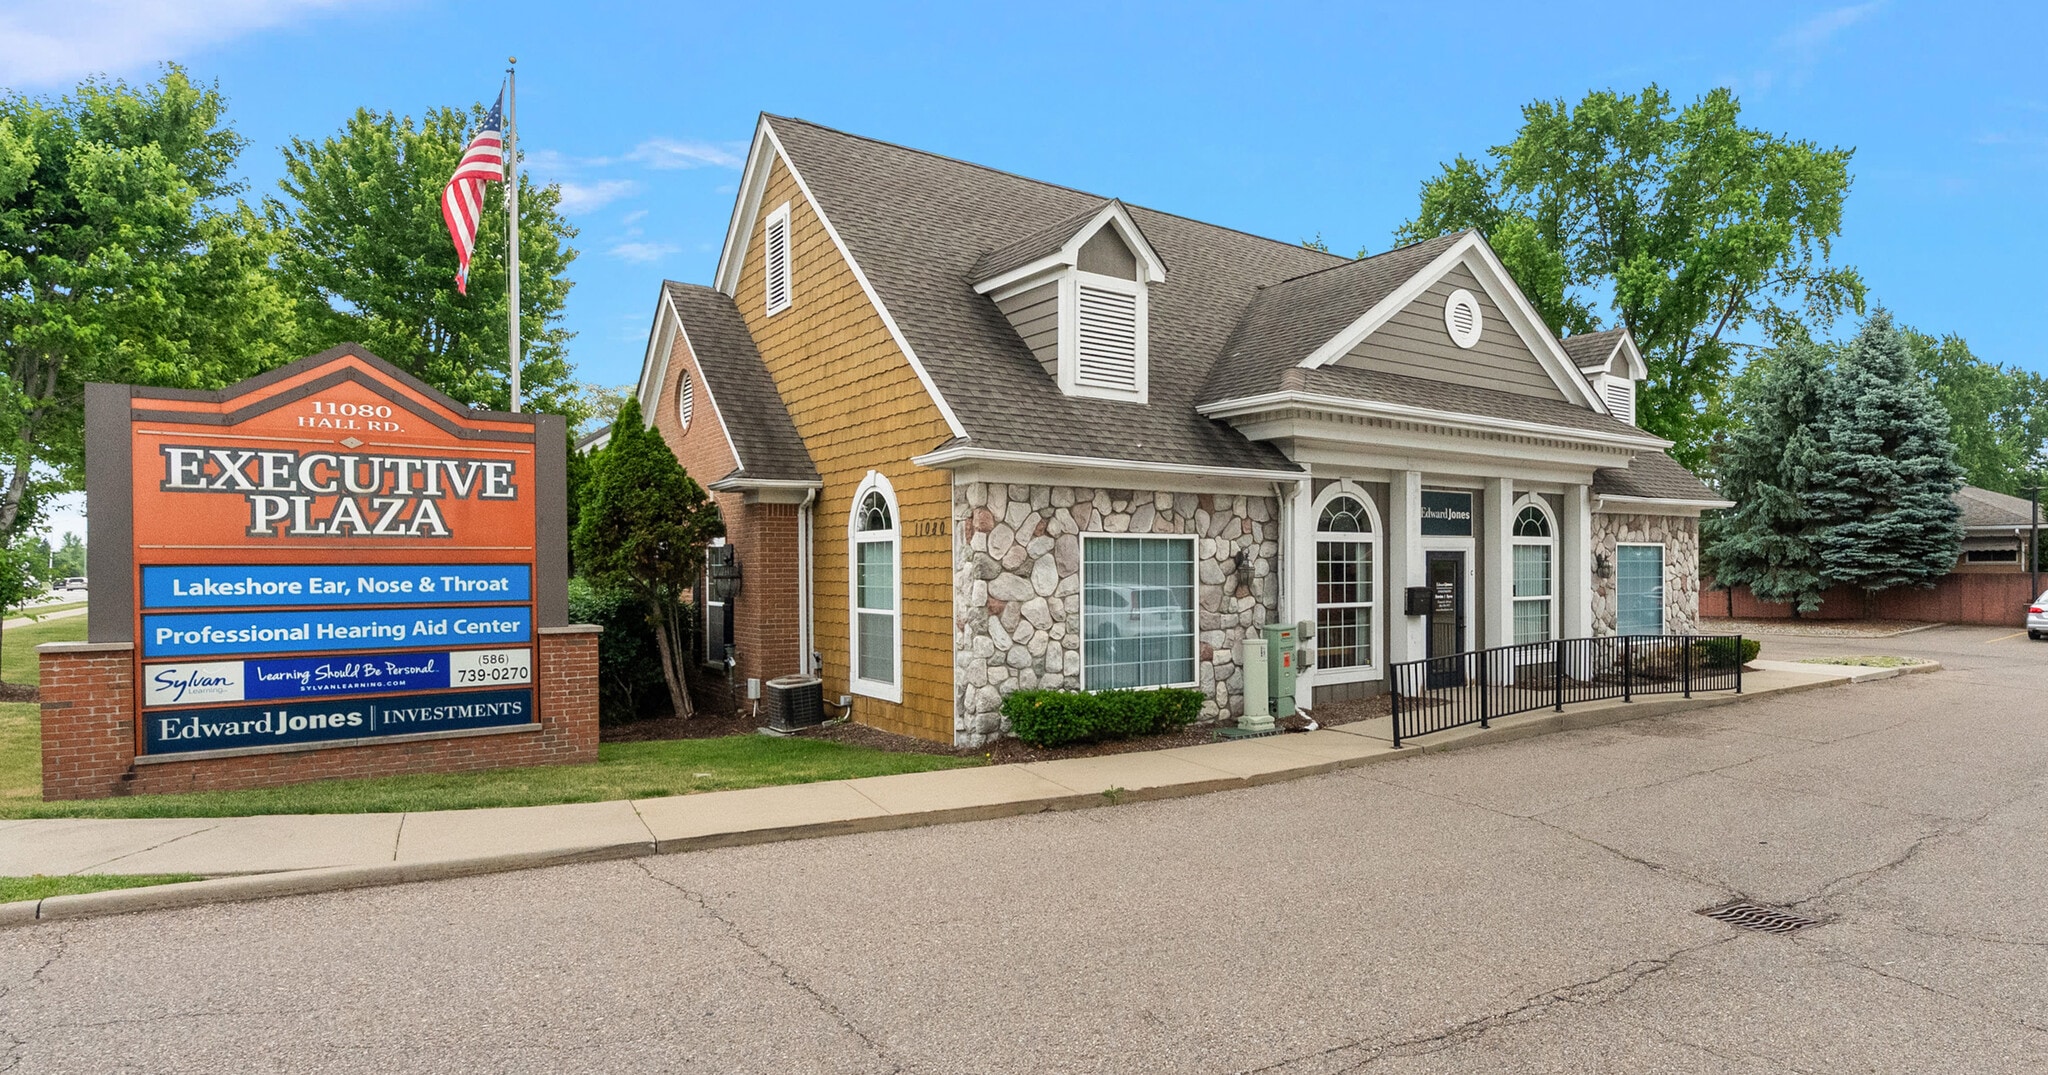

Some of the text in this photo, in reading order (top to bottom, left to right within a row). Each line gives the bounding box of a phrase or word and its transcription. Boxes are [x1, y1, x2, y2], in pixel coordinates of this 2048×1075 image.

[312, 401, 392, 418] 11080
[298, 416, 405, 432] HALL RD.
[163, 446, 516, 500] EXECUTIVE
[248, 494, 451, 537] PLAZA
[173, 576, 508, 596] Lakeshore Ear, Nose & Throat
[156, 619, 520, 645] Professional Hearing Aid Center
[478, 654, 509, 666] (586)
[257, 659, 434, 684] Learning Should Be Personal
[458, 666, 528, 683] 739-0270
[154, 669, 234, 702] Sylvan
[188, 686, 224, 694] Learning
[300, 680, 406, 691] SYLVANLEARNING.COM
[382, 701, 523, 725] INVESTMENTS
